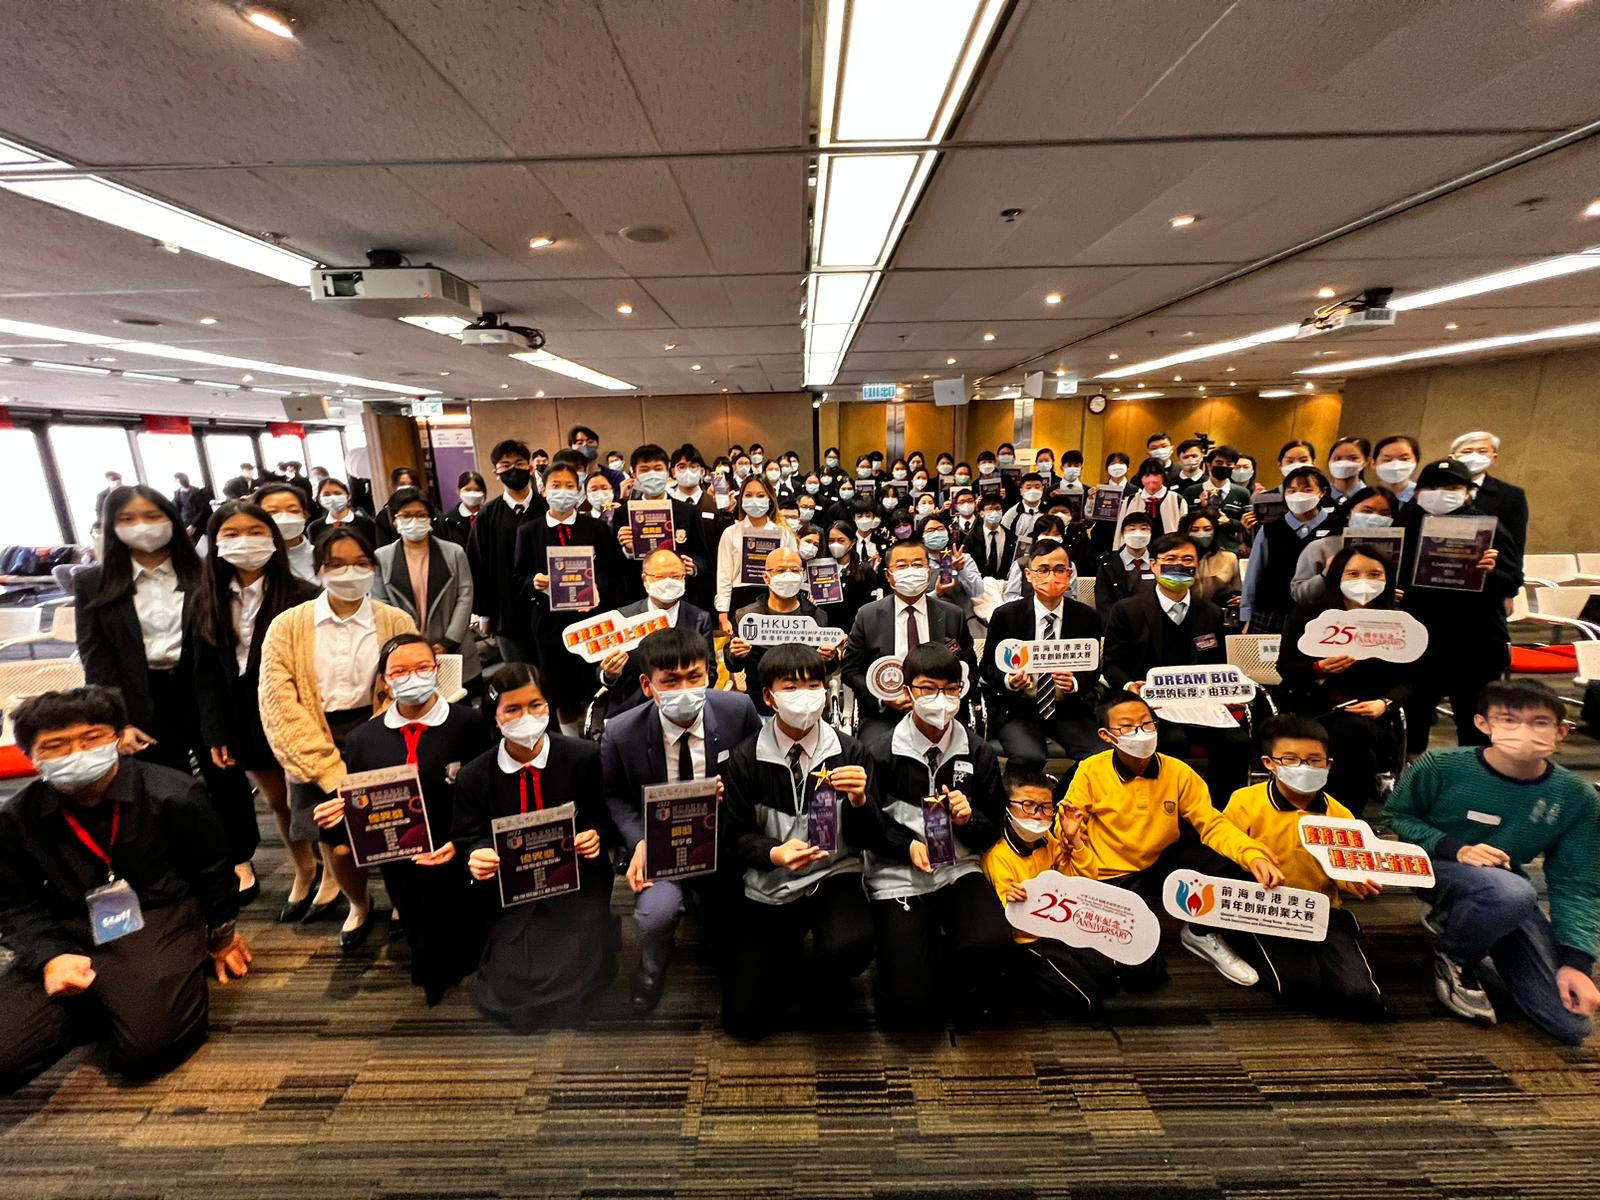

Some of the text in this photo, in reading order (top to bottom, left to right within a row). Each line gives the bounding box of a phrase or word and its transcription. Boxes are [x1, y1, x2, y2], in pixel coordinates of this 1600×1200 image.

[761, 619, 808, 629] HKUST
[1318, 625, 1357, 645] 25
[1153, 672, 1239, 686] DREAM BIG
[1030, 893, 1078, 923] 25
[1221, 886, 1316, 909] 前海粵港澳台
[1221, 899, 1315, 922] 青年創新創業大賽
[1077, 917, 1129, 940] ANNIVERSARY
